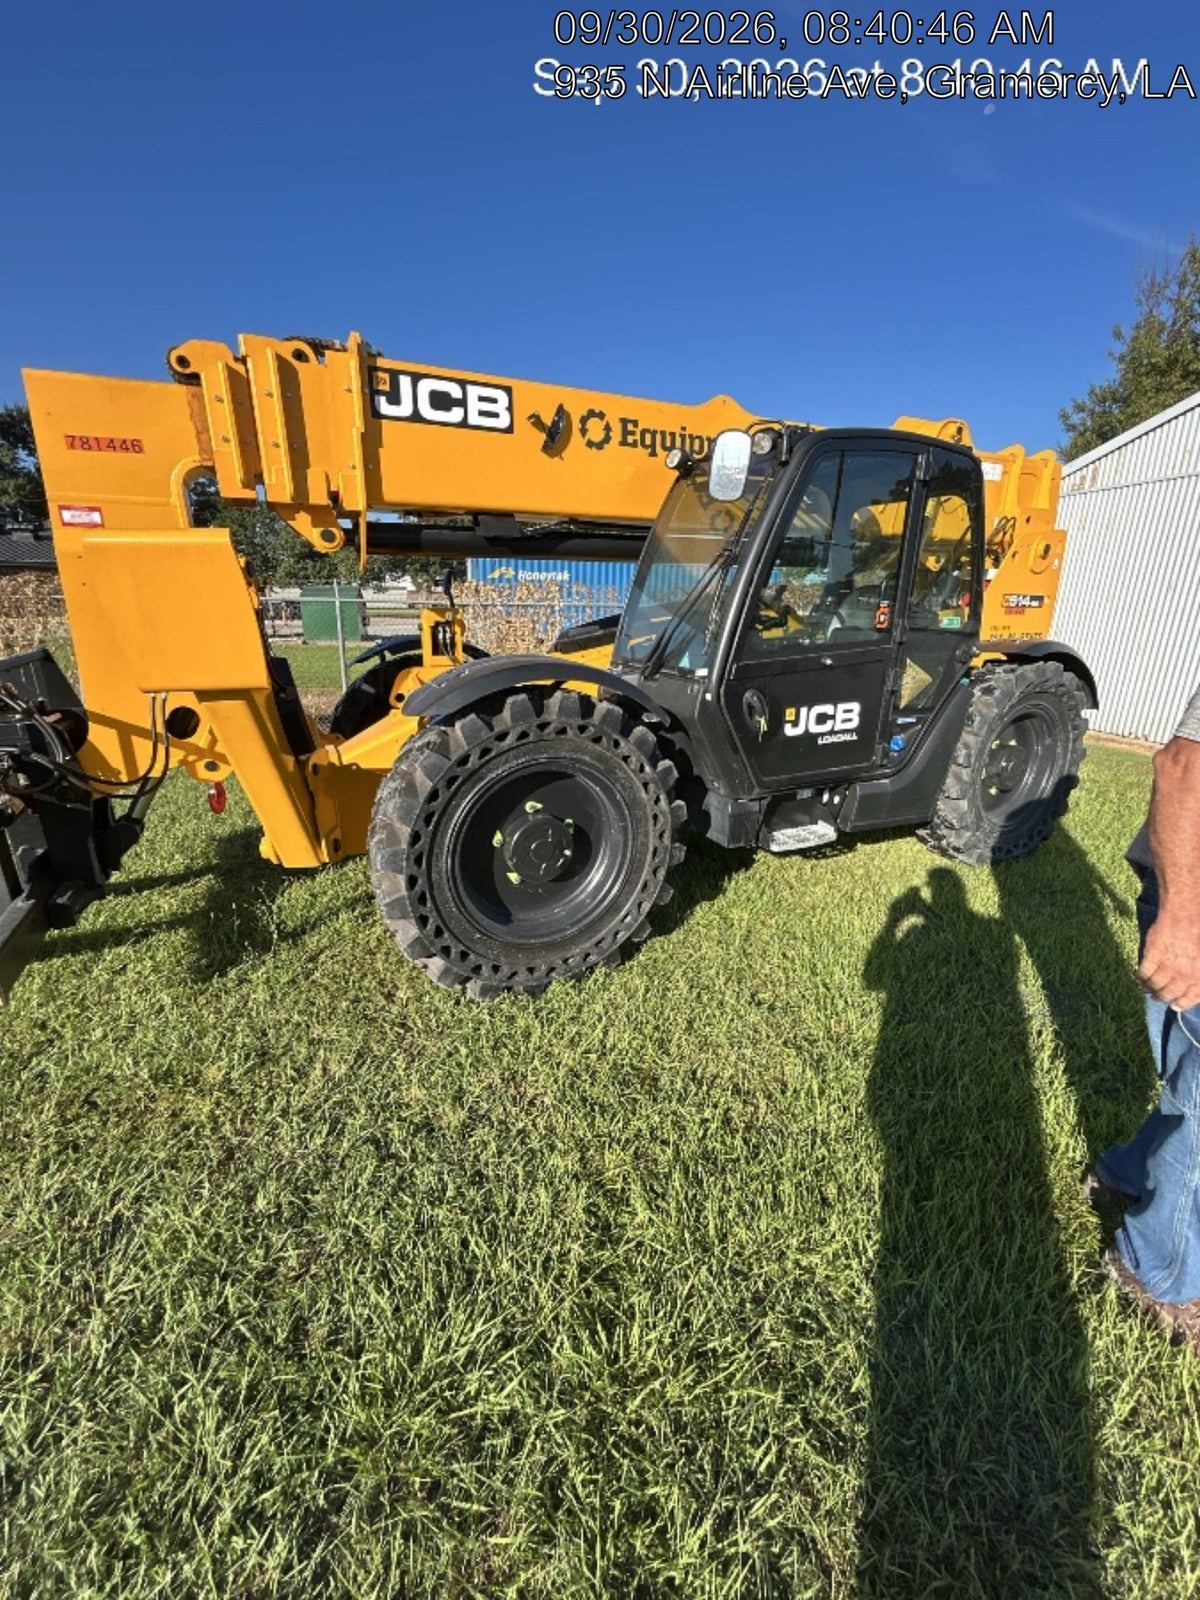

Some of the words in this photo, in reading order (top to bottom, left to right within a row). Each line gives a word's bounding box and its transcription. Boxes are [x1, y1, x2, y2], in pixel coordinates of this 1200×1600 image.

[374, 374, 511, 430] JCB
[65, 434, 143, 454] 781446
[784, 702, 861, 737] JCB
[817, 732, 858, 745] LOADALL
